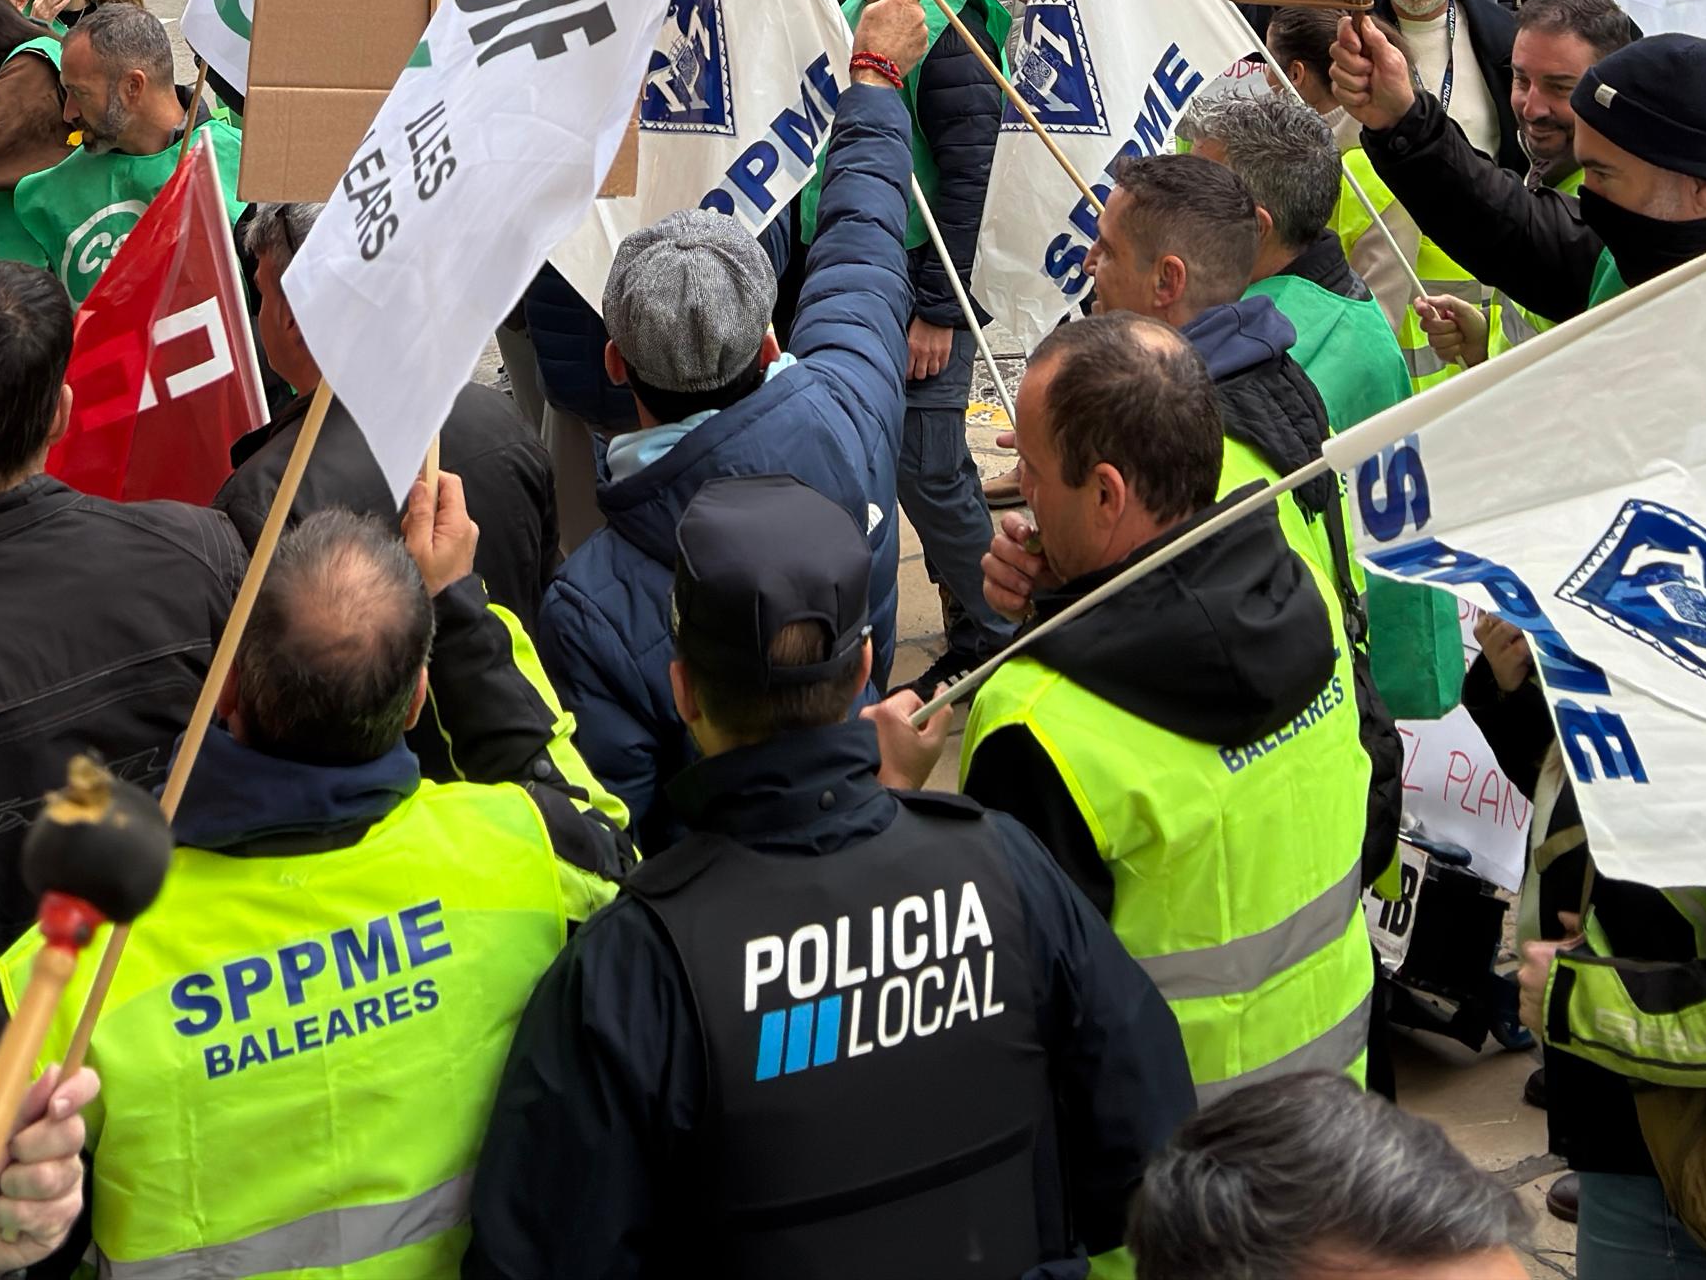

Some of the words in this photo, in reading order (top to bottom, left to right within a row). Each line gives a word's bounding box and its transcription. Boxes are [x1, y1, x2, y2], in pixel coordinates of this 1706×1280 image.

[342, 130, 399, 262] EARS
[1444, 749, 1530, 832] PLAN
[168, 897, 455, 1039] SPPME
[742, 880, 994, 1014] POLICIA
[845, 950, 1006, 1061] LOCAL
[203, 976, 440, 1081] BALEARES
